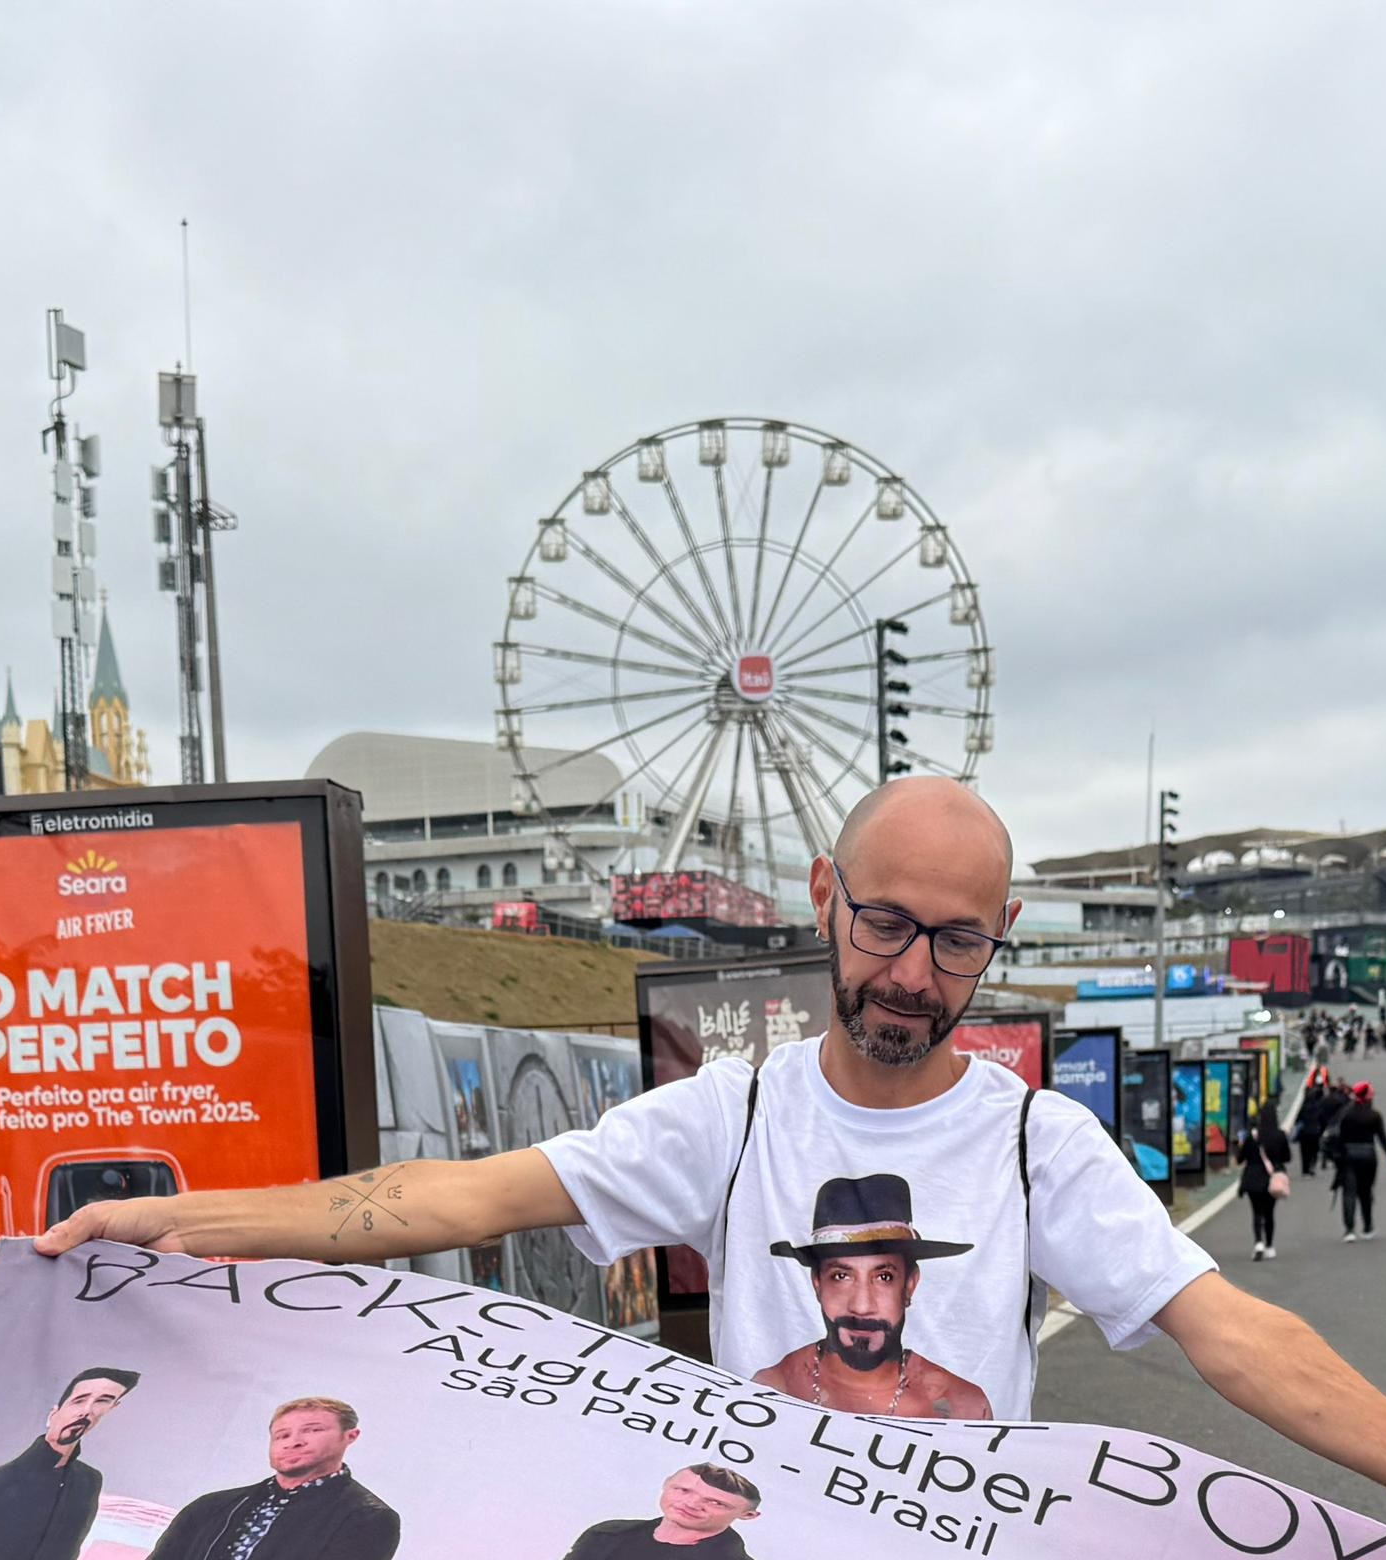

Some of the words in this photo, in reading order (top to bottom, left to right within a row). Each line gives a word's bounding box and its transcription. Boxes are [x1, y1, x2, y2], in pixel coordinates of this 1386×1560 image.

[45, 809, 154, 833] eletromidia
[58, 875, 128, 896] Seara
[56, 917, 84, 940] AIR
[85, 908, 135, 936] FRYER
[27, 960, 234, 1018] MATCH
[88, 1087, 124, 1110] pra
[128, 1082, 159, 1104] air
[160, 1080, 219, 1109] fryer,
[53, 1112, 90, 1132] pro
[92, 1105, 134, 1128] The
[136, 1105, 197, 1125] Town
[200, 1101, 260, 1122] 2025.
[402, 1333, 778, 1428] Augusto
[809, 1414, 1073, 1526] Luper
[440, 1368, 559, 1407] São
[581, 1395, 755, 1464] Paulo
[823, 1465, 999, 1556] Brasil
